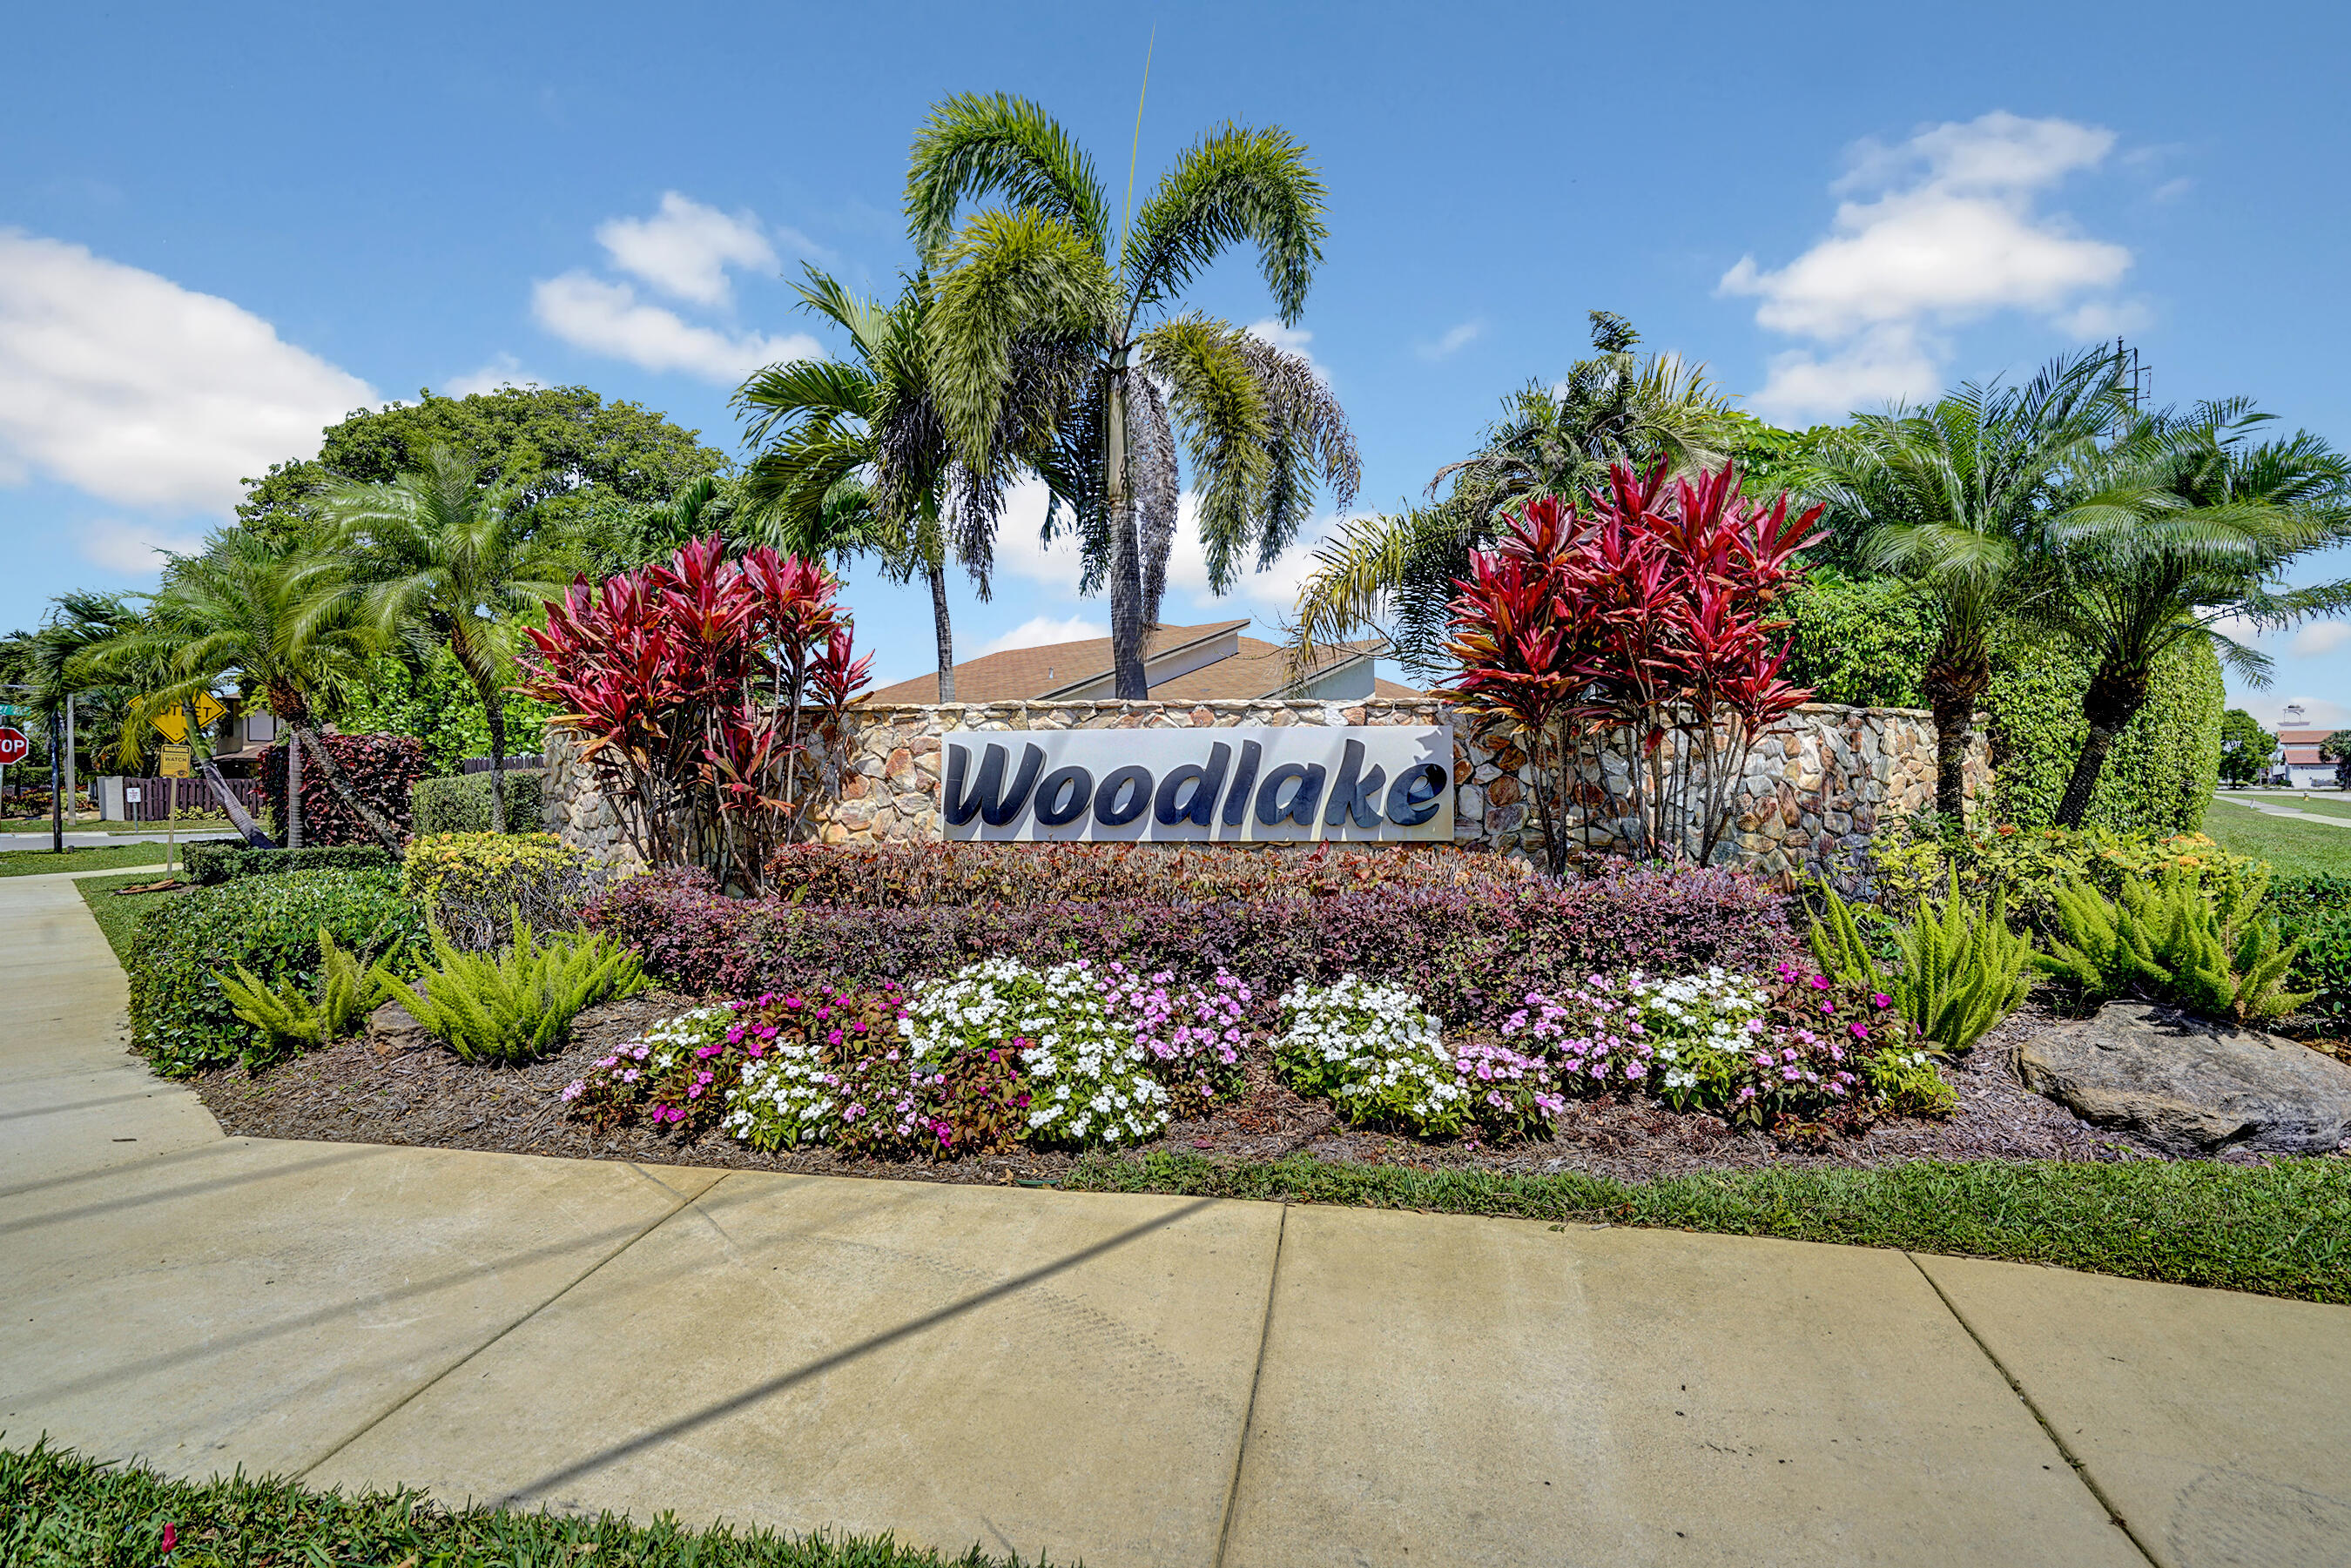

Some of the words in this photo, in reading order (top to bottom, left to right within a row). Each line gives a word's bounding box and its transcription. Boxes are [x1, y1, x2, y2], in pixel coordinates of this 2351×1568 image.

[157, 704, 212, 718] UTLET
[0, 739, 25, 753] OP
[944, 738, 1448, 827] Woodlake
